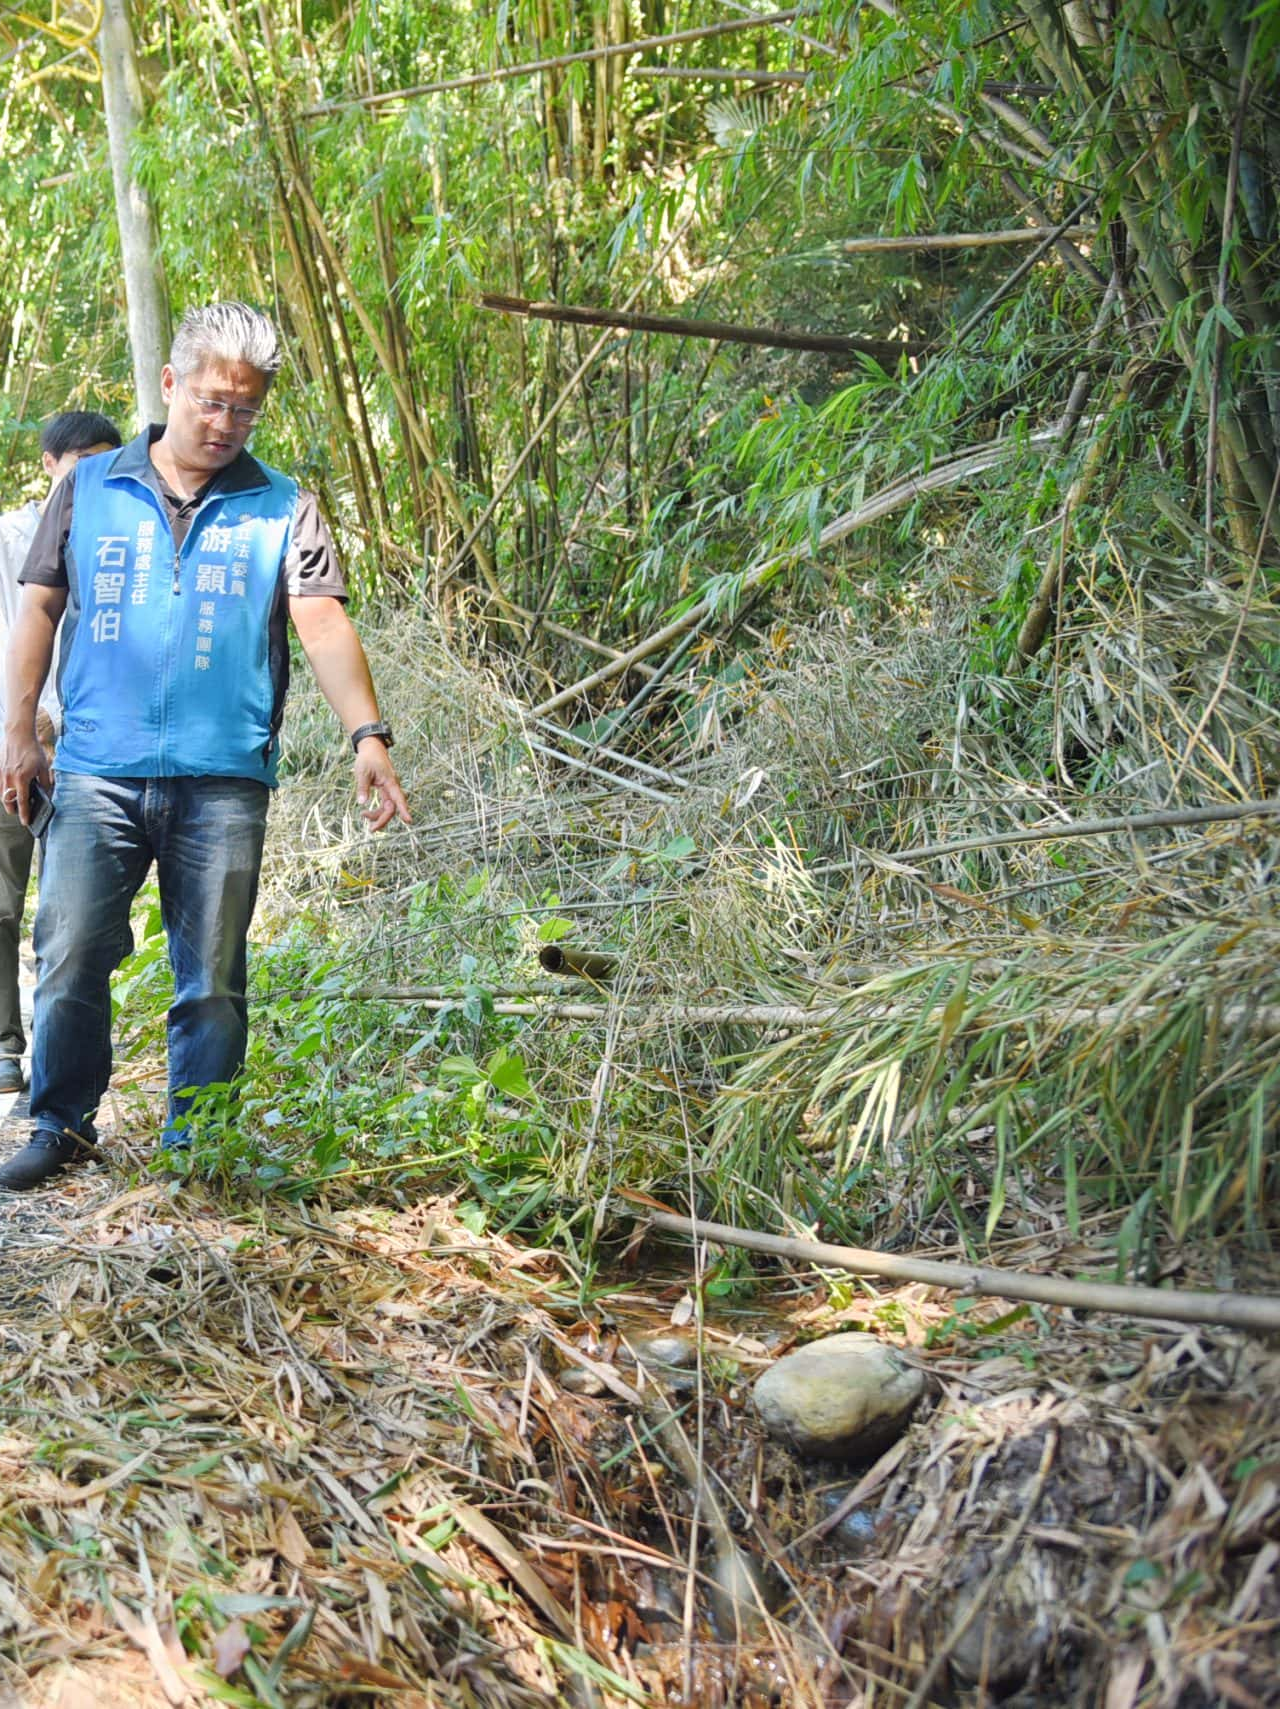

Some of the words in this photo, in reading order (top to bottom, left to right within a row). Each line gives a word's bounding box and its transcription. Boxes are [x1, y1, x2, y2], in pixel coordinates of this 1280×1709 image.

[90, 536, 130, 643] 石智伯
[195, 524, 233, 595] 游顥
[229, 526, 251, 597] 立法委員
[194, 600, 216, 671] 服務團隊
